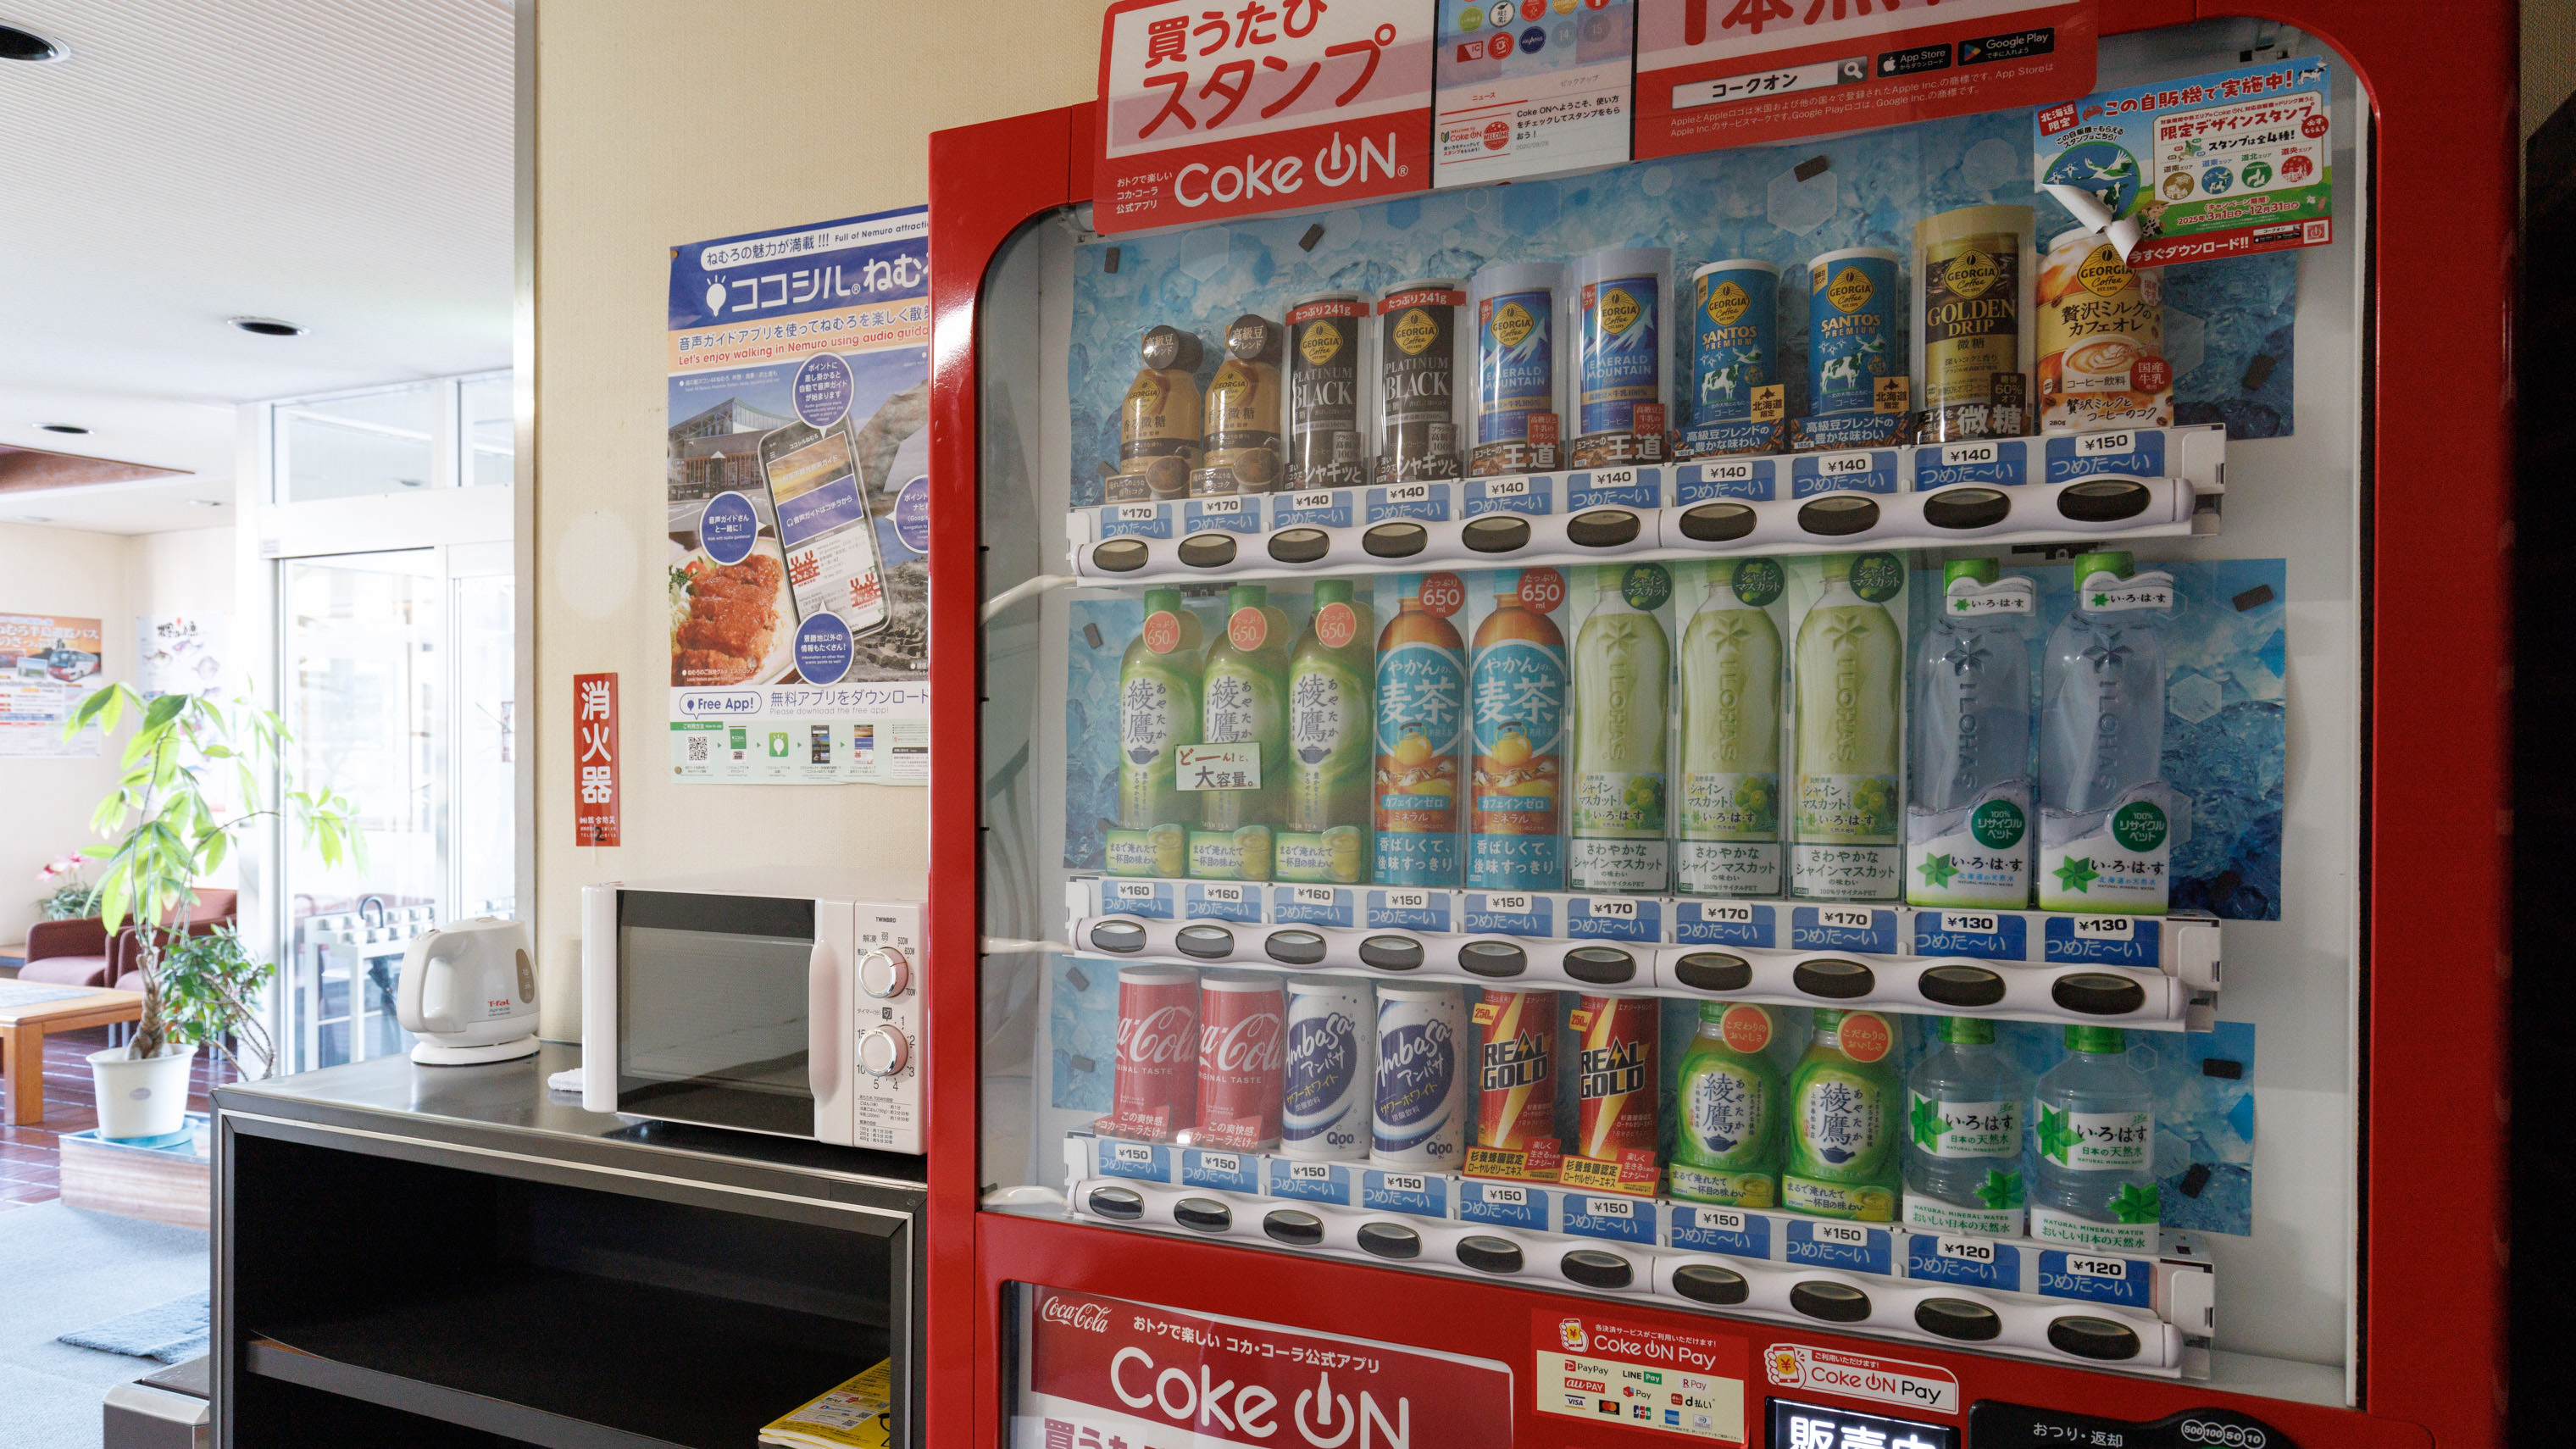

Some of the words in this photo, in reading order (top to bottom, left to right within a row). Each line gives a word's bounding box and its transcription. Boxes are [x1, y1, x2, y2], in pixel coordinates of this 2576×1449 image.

[1986, 36, 2024, 50] Google
[2027, 33, 2049, 43] Play
[1900, 53, 1918, 63] App
[1921, 49, 1946, 59] Store
[1138, 23, 1396, 139] スタンプ
[1713, 74, 1798, 97] コークオン
[1472, 92, 1496, 101] ニュース
[2104, 69, 2293, 116] この自販機で実施中!
[1517, 106, 1537, 117] Coke
[2040, 104, 2075, 122] 北海道
[2048, 117, 2071, 131] 限定
[2161, 102, 2314, 140] 限定デザインスタンプ
[1117, 171, 1172, 187] おトクで楽しい
[1174, 154, 1303, 208] Coke
[1116, 199, 1158, 214] 公式アプリ
[707, 235, 814, 266] ねむろの魅力が満載
[835, 233, 849, 242] Full
[852, 231, 859, 240] of
[862, 226, 893, 238] Nemuro
[896, 220, 928, 232] attracti
[1927, 299, 2016, 326] GOLDEN
[1822, 314, 1880, 332] SANTOS
[1948, 319, 1995, 337] DRIP
[2069, 317, 2144, 337] カフェオレ
[1396, 327, 1435, 338] GEORGIA
[1702, 325, 1757, 346] SANTOS
[1825, 327, 1876, 339] PREMIUM
[679, 353, 700, 366] Let's
[703, 346, 730, 364] enjoy
[733, 341, 772, 360] walking
[774, 342, 785, 354] in
[788, 338, 827, 353] Nemuro
[830, 335, 859, 347] using
[863, 328, 893, 344] audio
[1302, 337, 1340, 348] GEORGIA
[1706, 338, 1752, 351] PREMIUM
[2138, 362, 2164, 373] 国産
[1385, 371, 1450, 400] BLACK
[2067, 375, 2125, 389] コーヒー飲料
[2138, 372, 2164, 385] 牛乳
[1295, 381, 1353, 408] BLACK
[1752, 399, 1783, 411] 北海道
[1957, 404, 2022, 435] 微糖
[2087, 407, 2157, 421] コーヒーのコク
[1686, 425, 1769, 441] 高級豆ブレンドの
[1695, 437, 1760, 452] 豊かな味わい
[2085, 434, 2127, 450] ¥150
[1951, 448, 1990, 462] ¥140
[1710, 465, 1746, 478] ¥140
[1828, 458, 1866, 472] ¥140
[1597, 470, 1631, 485] ¥140
[1390, 486, 1424, 499] ¥140
[1491, 481, 1524, 494] ¥140
[1207, 500, 1238, 512] ¥170
[1296, 494, 1329, 506] ¥140
[708, 514, 750, 525] 音声ガイドさん
[1122, 508, 1152, 519] ¥170
[1423, 589, 1460, 606] 650
[1522, 584, 1560, 602] 650
[698, 697, 722, 710] Free
[725, 697, 753, 710] App!
[1380, 676, 1460, 725] 麦茶
[1474, 675, 1561, 724] 麦茶
[1127, 677, 1155, 745] 綾鷹
[581, 680, 612, 804] 消火器
[1385, 797, 1443, 808] カフェインゼロ
[1394, 812, 1429, 822] ミネラル
[1979, 819, 2023, 830] リサイクル
[595, 826, 606, 841] 2
[1586, 843, 1646, 857] さわやかな
[1378, 855, 1452, 871] 後味すっきり
[1474, 858, 1554, 874] 後味すっきり
[1574, 857, 1662, 870] シャインマスカット
[1796, 863, 1895, 878] シャインマスカット
[1120, 886, 1150, 896] ¥160
[1208, 890, 1239, 900] ¥160
[1298, 889, 1330, 901] ¥160
[1392, 895, 1422, 906] ¥150
[1492, 897, 1524, 908] ¥150
[1595, 903, 1632, 913] ¥170
[1707, 906, 1749, 920] ¥170
[1825, 913, 1868, 925] ¥170
[1947, 917, 1993, 929] ¥130
[2079, 919, 2127, 931] ¥130
[1843, 1028, 1886, 1040] こだわりの
[1484, 1029, 1548, 1067] REAL
[909, 1067, 914, 1077] 3
[1483, 1056, 1548, 1091] GOLD
[874, 1080, 879, 1089] 5
[893, 1081, 898, 1091] 4
[1580, 1064, 1645, 1099] GOLD
[1735, 1079, 1745, 1130] あやたか
[1327, 1132, 1354, 1145] Qoo
[1951, 1134, 2008, 1144] 日本の天然水
[1119, 1149, 1148, 1159] ¥150
[1426, 1142, 1452, 1155] Qoo
[1205, 1157, 1236, 1169] ¥150
[1471, 1151, 1524, 1165] 杉養蜂園認定
[1294, 1168, 1325, 1176] ¥150
[1468, 1164, 1522, 1175] ローヤルゼリーエキス
[1387, 1178, 1421, 1189] ¥150
[1490, 1189, 1522, 1201] ¥150
[1595, 1202, 1628, 1213] ¥150
[1915, 1205, 1946, 1215] NATURAL
[1949, 1210, 1981, 1219] MINERAL
[1703, 1213, 1739, 1226] ¥150
[1913, 1212, 2010, 1233] おいしい日本の天然水
[1823, 1227, 1862, 1241] ¥150
[1946, 1244, 1990, 1259] ¥120
[2074, 1261, 2122, 1276] ¥120
[1594, 1335, 1641, 1356] Coke
[1645, 1340, 1674, 1361] ON
[1679, 1347, 1716, 1370] Pay
[1815, 1352, 1879, 1368] ご利用いただけます!
[1577, 1363, 1608, 1376] PayPay
[1623, 1370, 1641, 1380] LINE
[1646, 1374, 1660, 1383] Pay
[1110, 1346, 1278, 1438] Coke
[1811, 1367, 1861, 1388] Coke
[1866, 1373, 1896, 1393] ON
[1901, 1381, 1941, 1404] Pay
[1635, 1390, 1652, 1400] Pay
[1568, 1398, 1584, 1407] VISA
[2185, 1425, 2202, 1435] 500
[2205, 1428, 2223, 1438] 100
[2226, 1431, 2240, 1441] 50
[2247, 1434, 2261, 1444] 10
